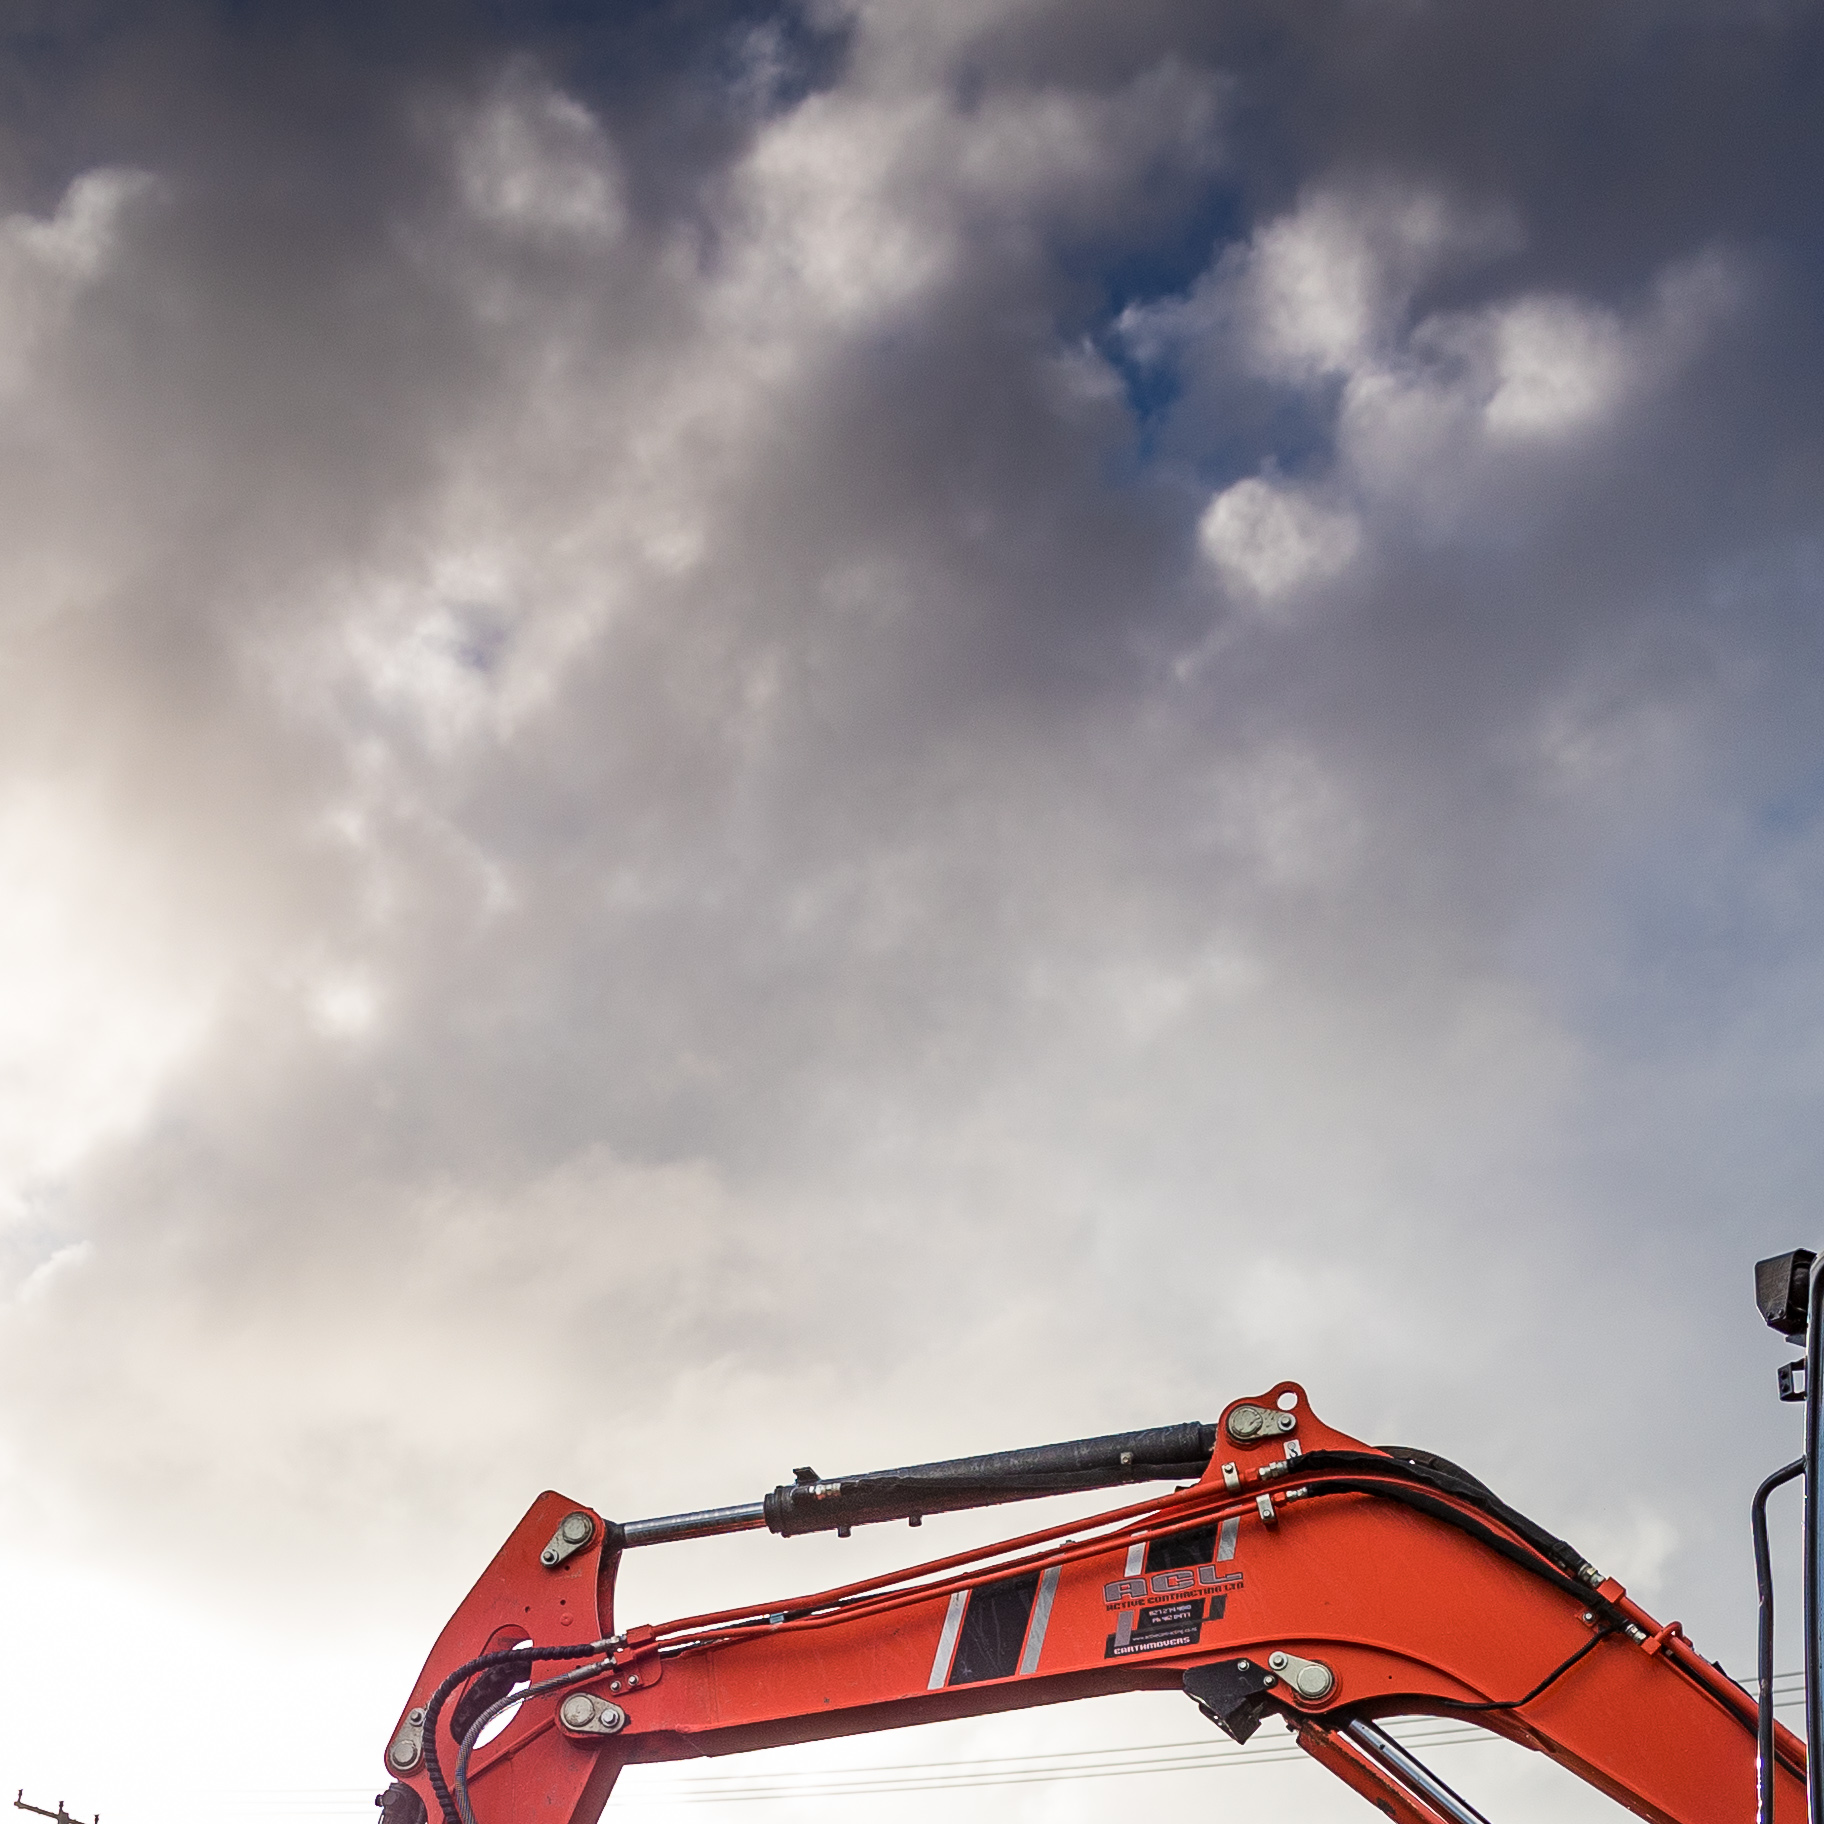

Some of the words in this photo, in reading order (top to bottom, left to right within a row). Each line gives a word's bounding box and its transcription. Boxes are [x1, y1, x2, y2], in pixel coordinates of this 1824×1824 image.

[1103, 1564, 1243, 1605] ACL
[1106, 1599, 1146, 1611] ACTIVE
[1147, 1586, 1222, 1604] CONTRACTING
[1225, 1582, 1244, 1591] LTD
[1114, 1637, 1190, 1655] EARTHMOVERS
